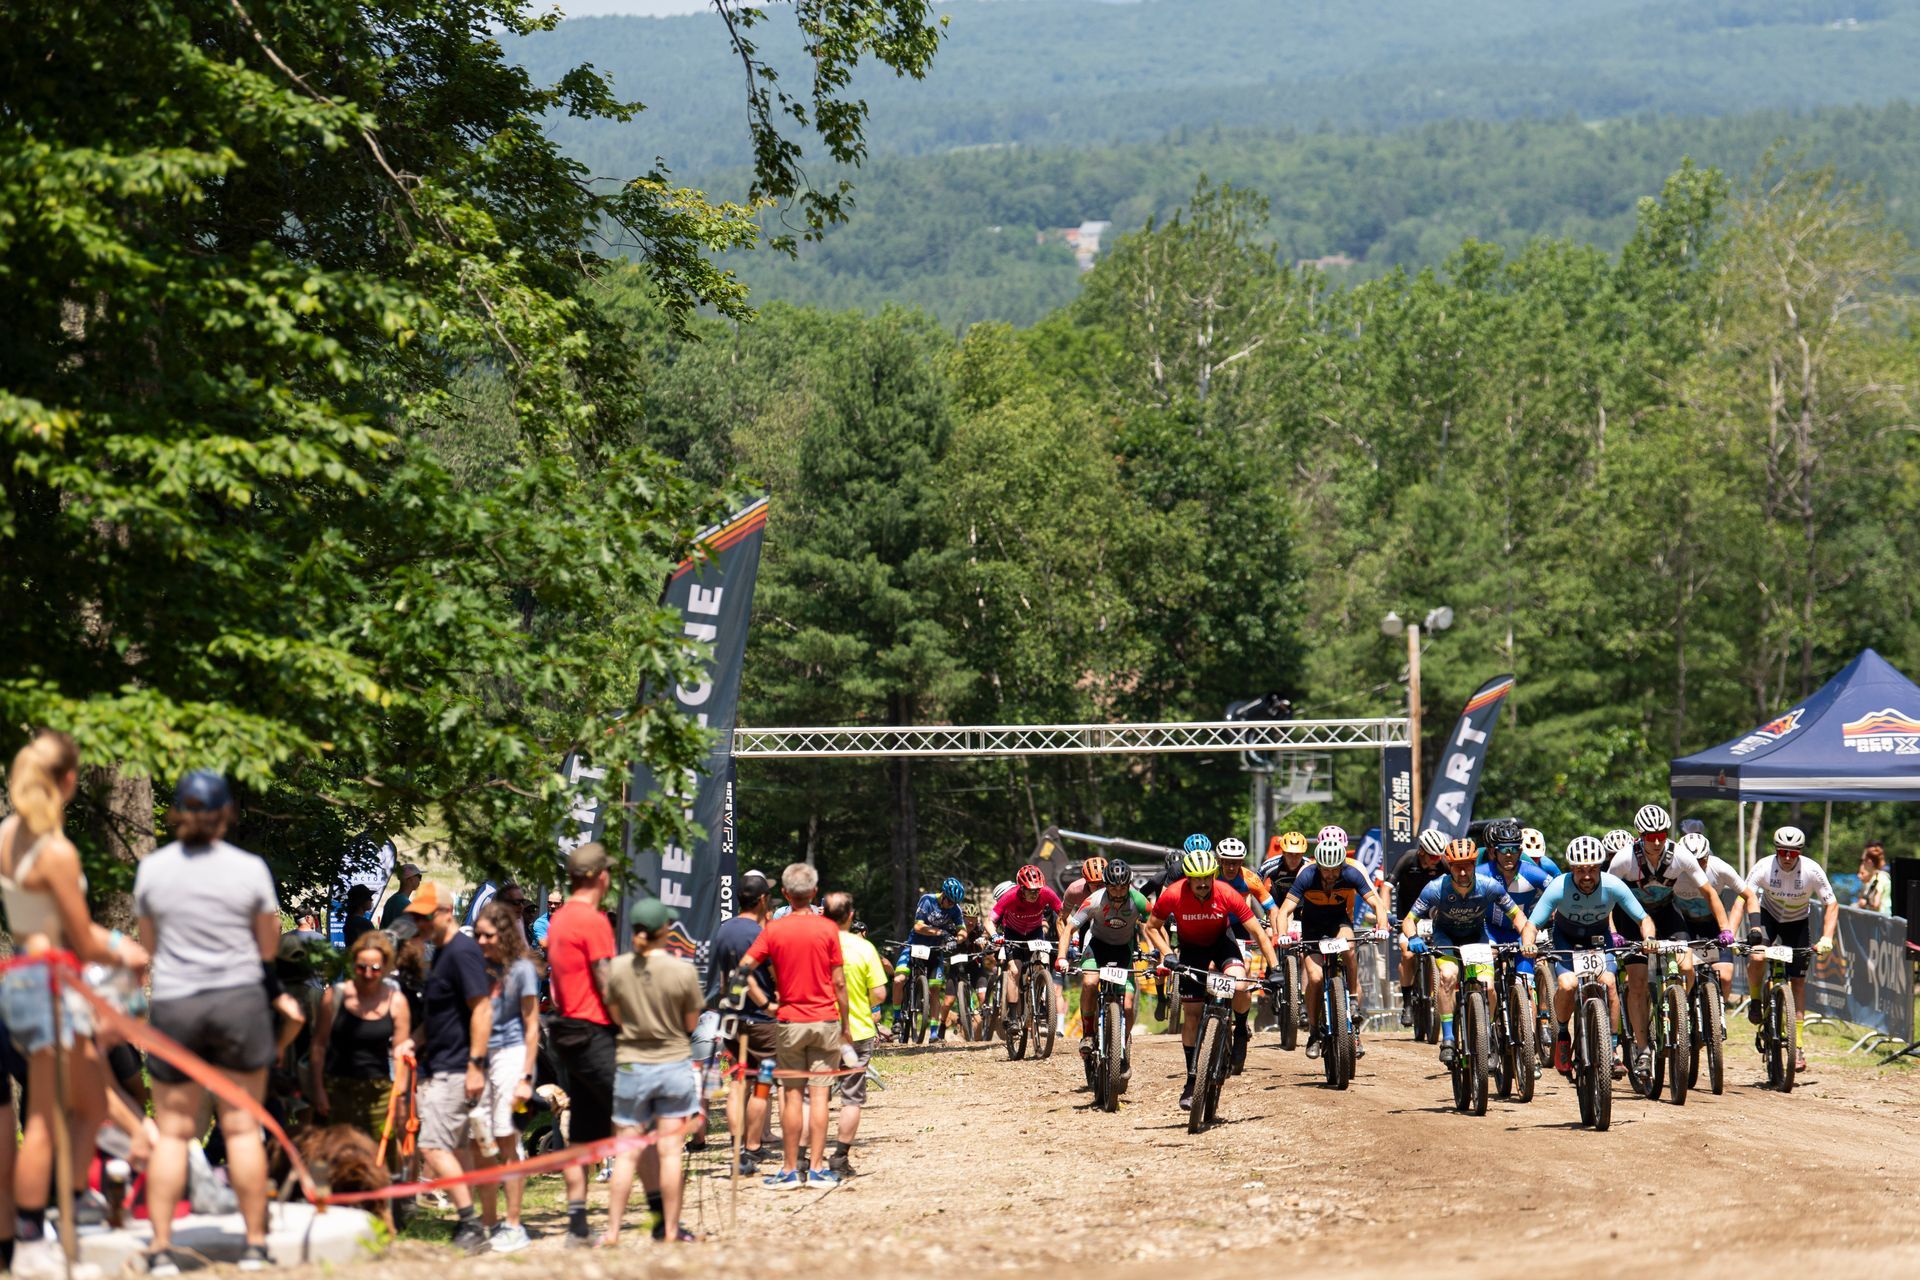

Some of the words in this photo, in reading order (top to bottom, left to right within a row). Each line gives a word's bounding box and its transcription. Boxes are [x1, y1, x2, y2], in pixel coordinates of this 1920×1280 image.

[676, 584, 724, 730] ONE
[1429, 716, 1487, 838] ART
[558, 754, 606, 868] ART
[720, 875, 733, 924] ROTA
[1182, 912, 1224, 921] BIKEMAN
[1212, 977, 1231, 993] 125
[1583, 955, 1598, 970] 36
